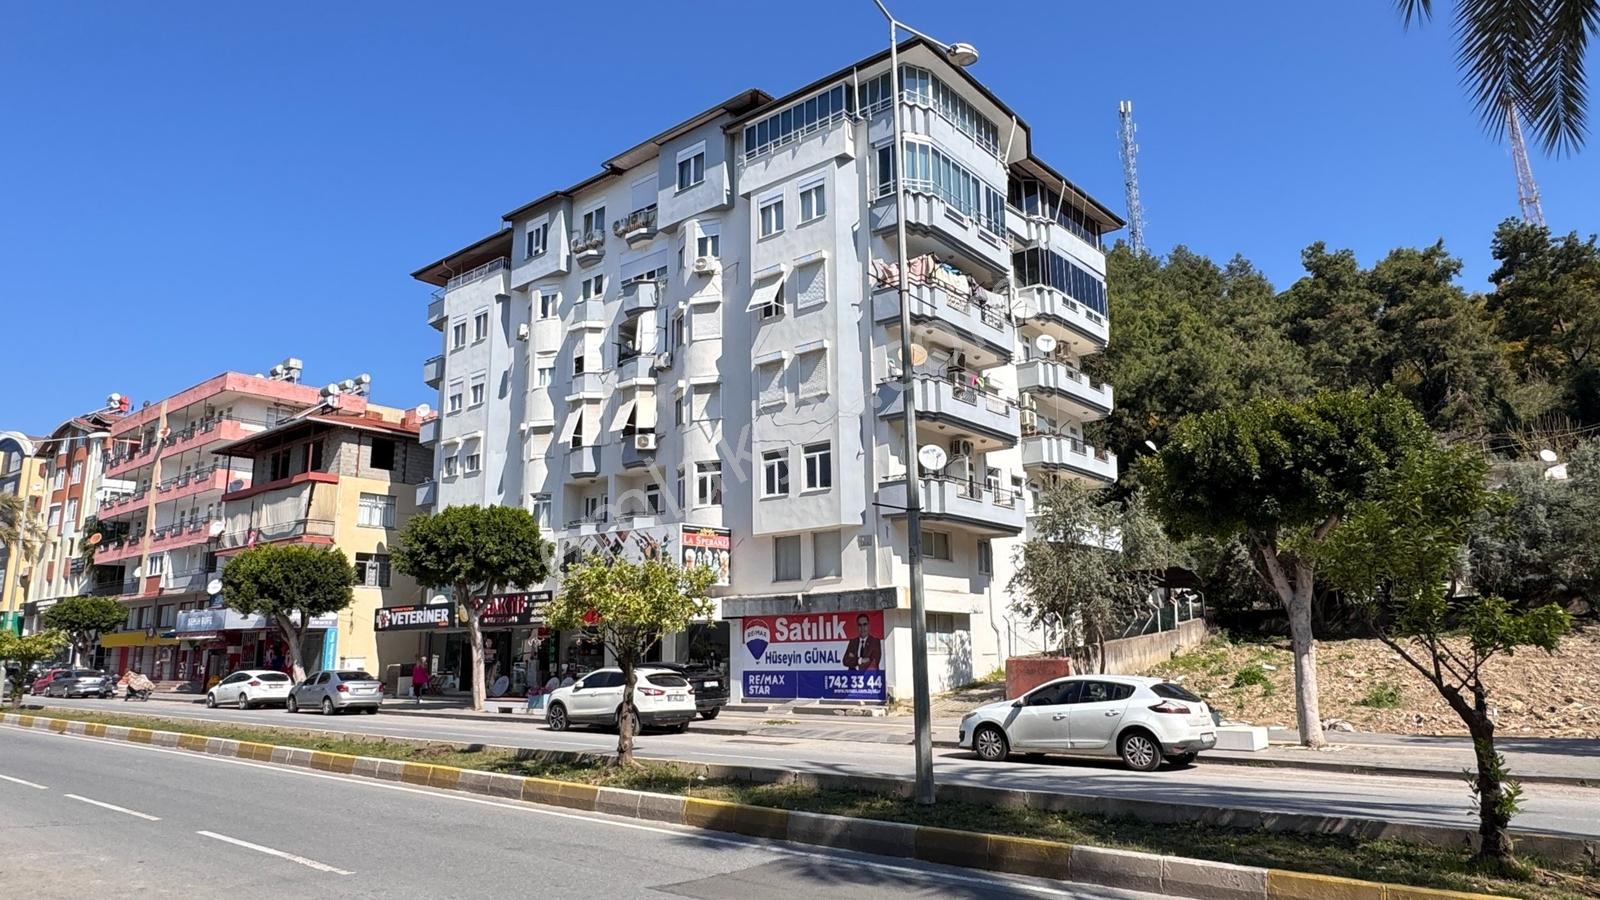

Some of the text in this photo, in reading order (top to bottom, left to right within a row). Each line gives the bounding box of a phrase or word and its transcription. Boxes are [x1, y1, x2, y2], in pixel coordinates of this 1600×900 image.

[391, 606, 449, 625] VETERİNER
[775, 615, 847, 641] Satılık
[765, 647, 841, 667] Hüseyin GÜNAL
[748, 674, 785, 685] RE/MAX
[828, 675, 848, 688] 742
[851, 675, 865, 688] 33
[867, 675, 883, 689] 44
[748, 685, 771, 695] STAR
